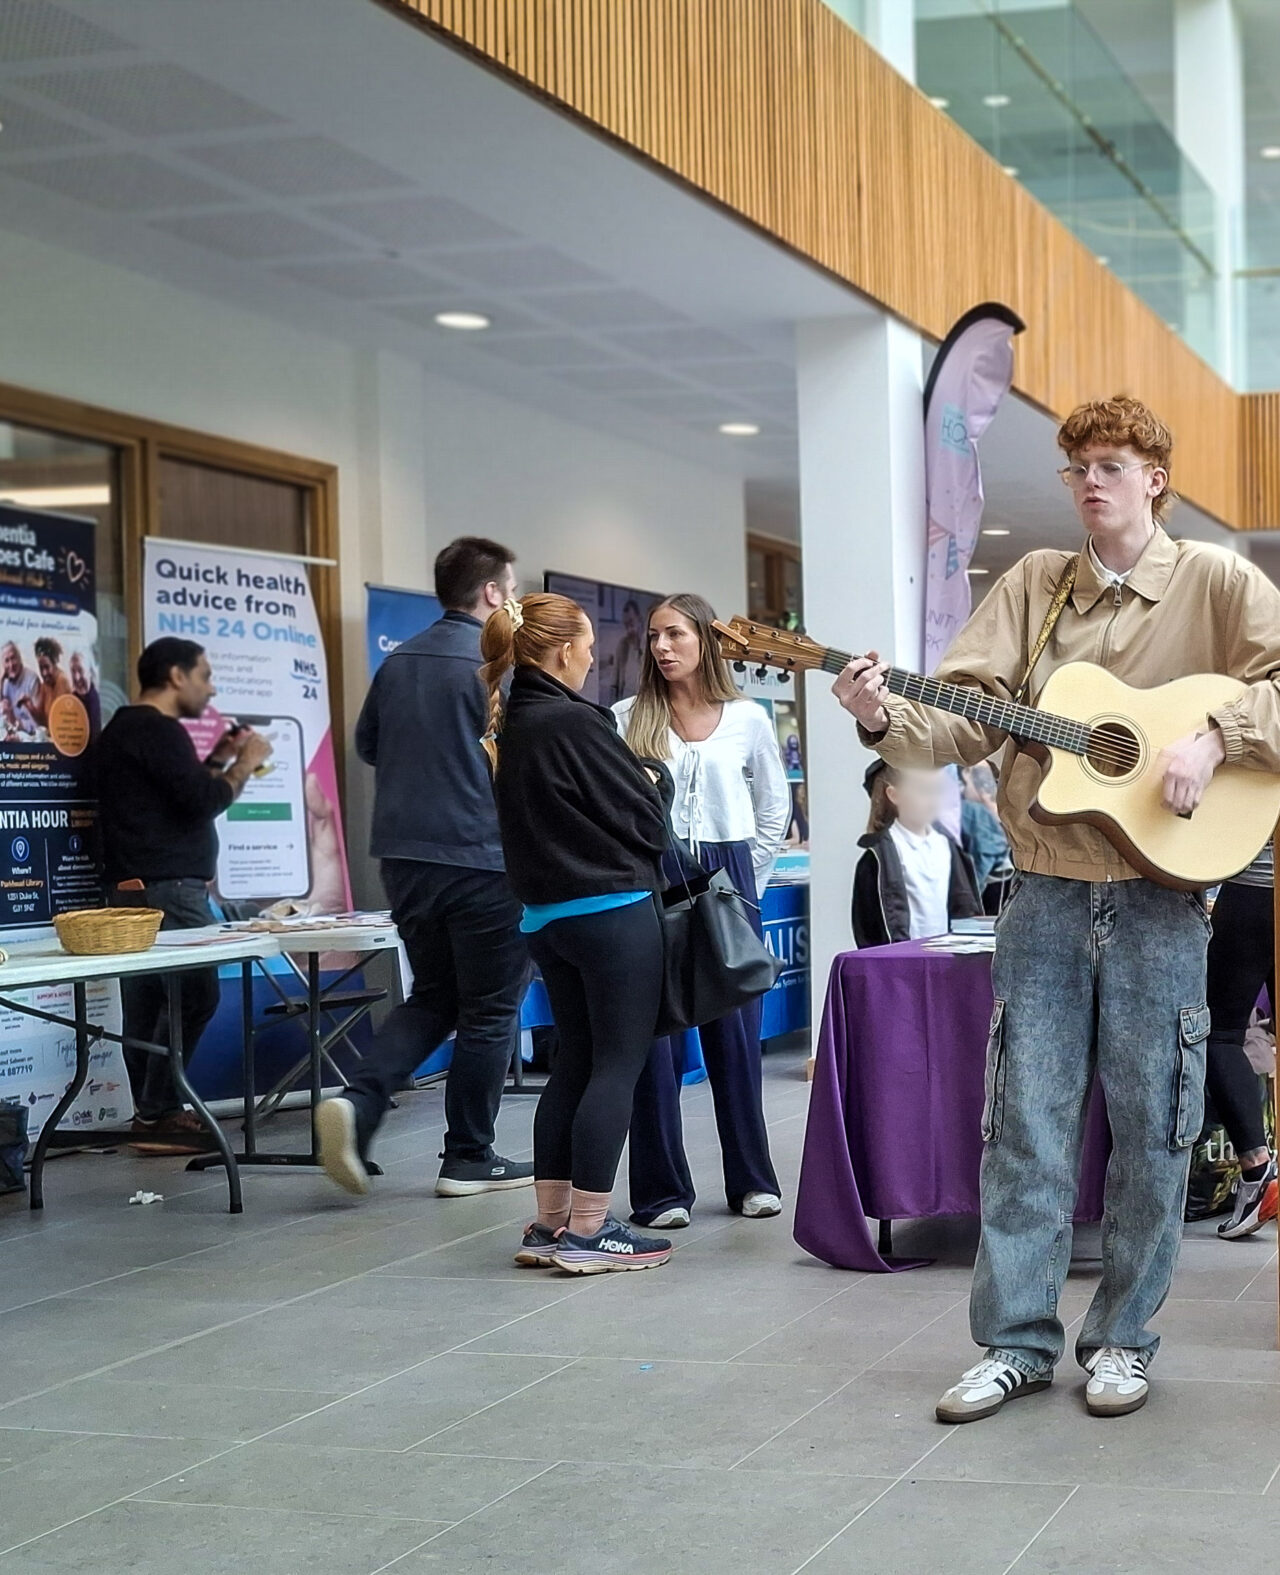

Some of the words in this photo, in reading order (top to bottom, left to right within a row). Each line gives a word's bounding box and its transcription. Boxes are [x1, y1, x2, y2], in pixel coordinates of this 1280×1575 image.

[0, 523, 36, 547] entia
[24, 547, 55, 572] Cafe
[156, 558, 229, 586] Quick
[236, 568, 306, 597] health
[156, 587, 237, 611] advice
[245, 594, 297, 619] from
[157, 612, 211, 635] NHS
[216, 618, 246, 639] 24
[253, 621, 317, 648] Online
[293, 658, 318, 677] NHS
[301, 685, 318, 700] 24
[32, 809, 69, 828] HOUR
[598, 1237, 634, 1255] HOKA
